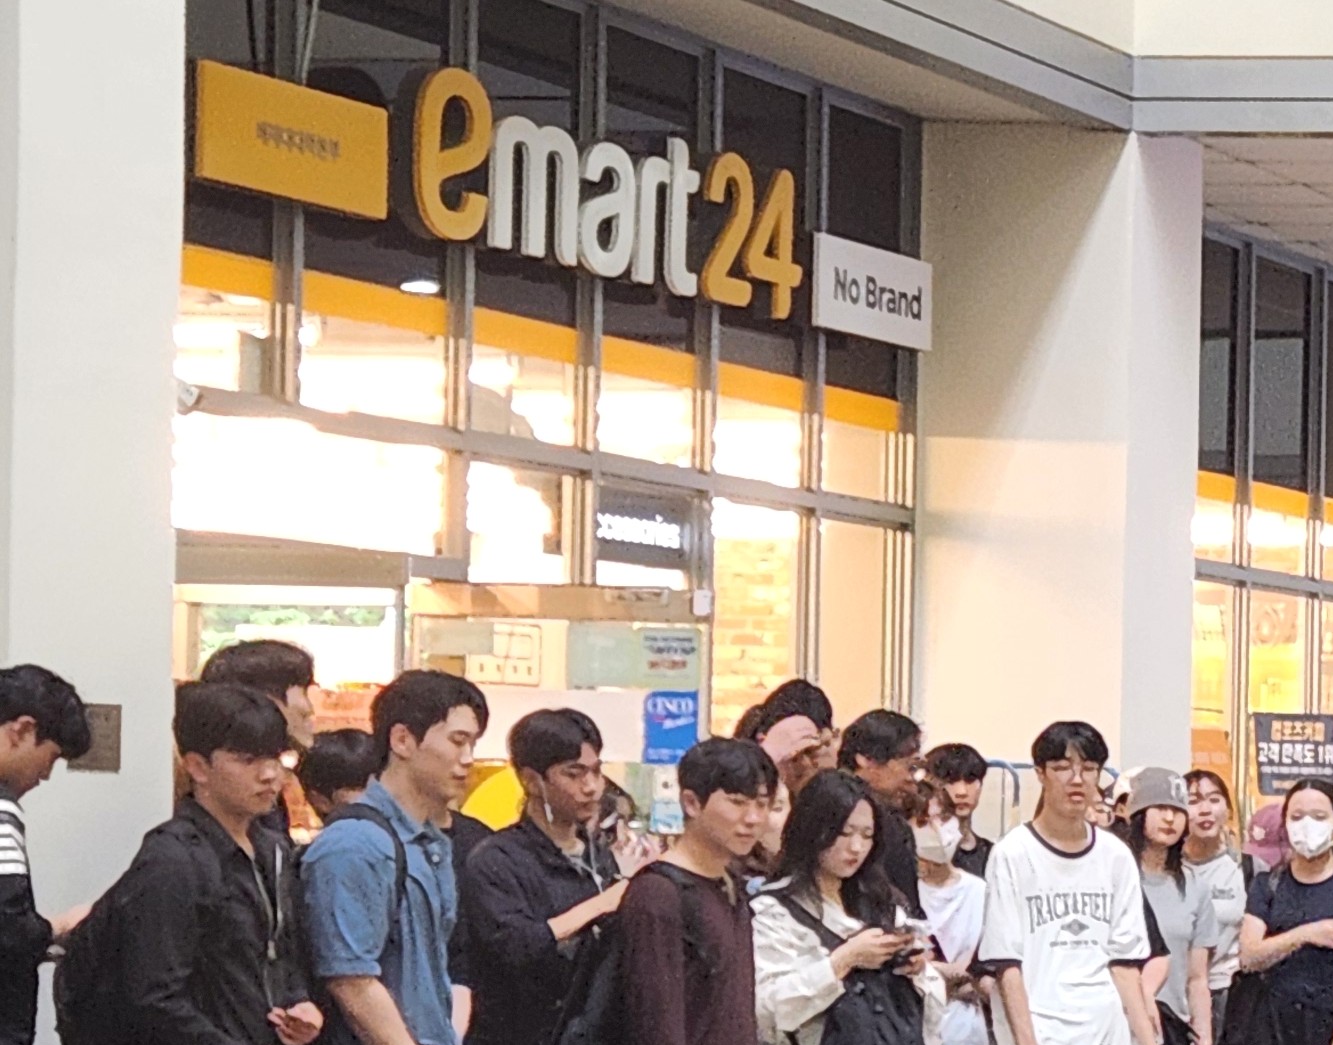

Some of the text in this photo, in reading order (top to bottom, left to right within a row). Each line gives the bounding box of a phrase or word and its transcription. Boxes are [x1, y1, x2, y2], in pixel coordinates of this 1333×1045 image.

[413, 67, 803, 320] emart24
[833, 266, 923, 322] No Brand
